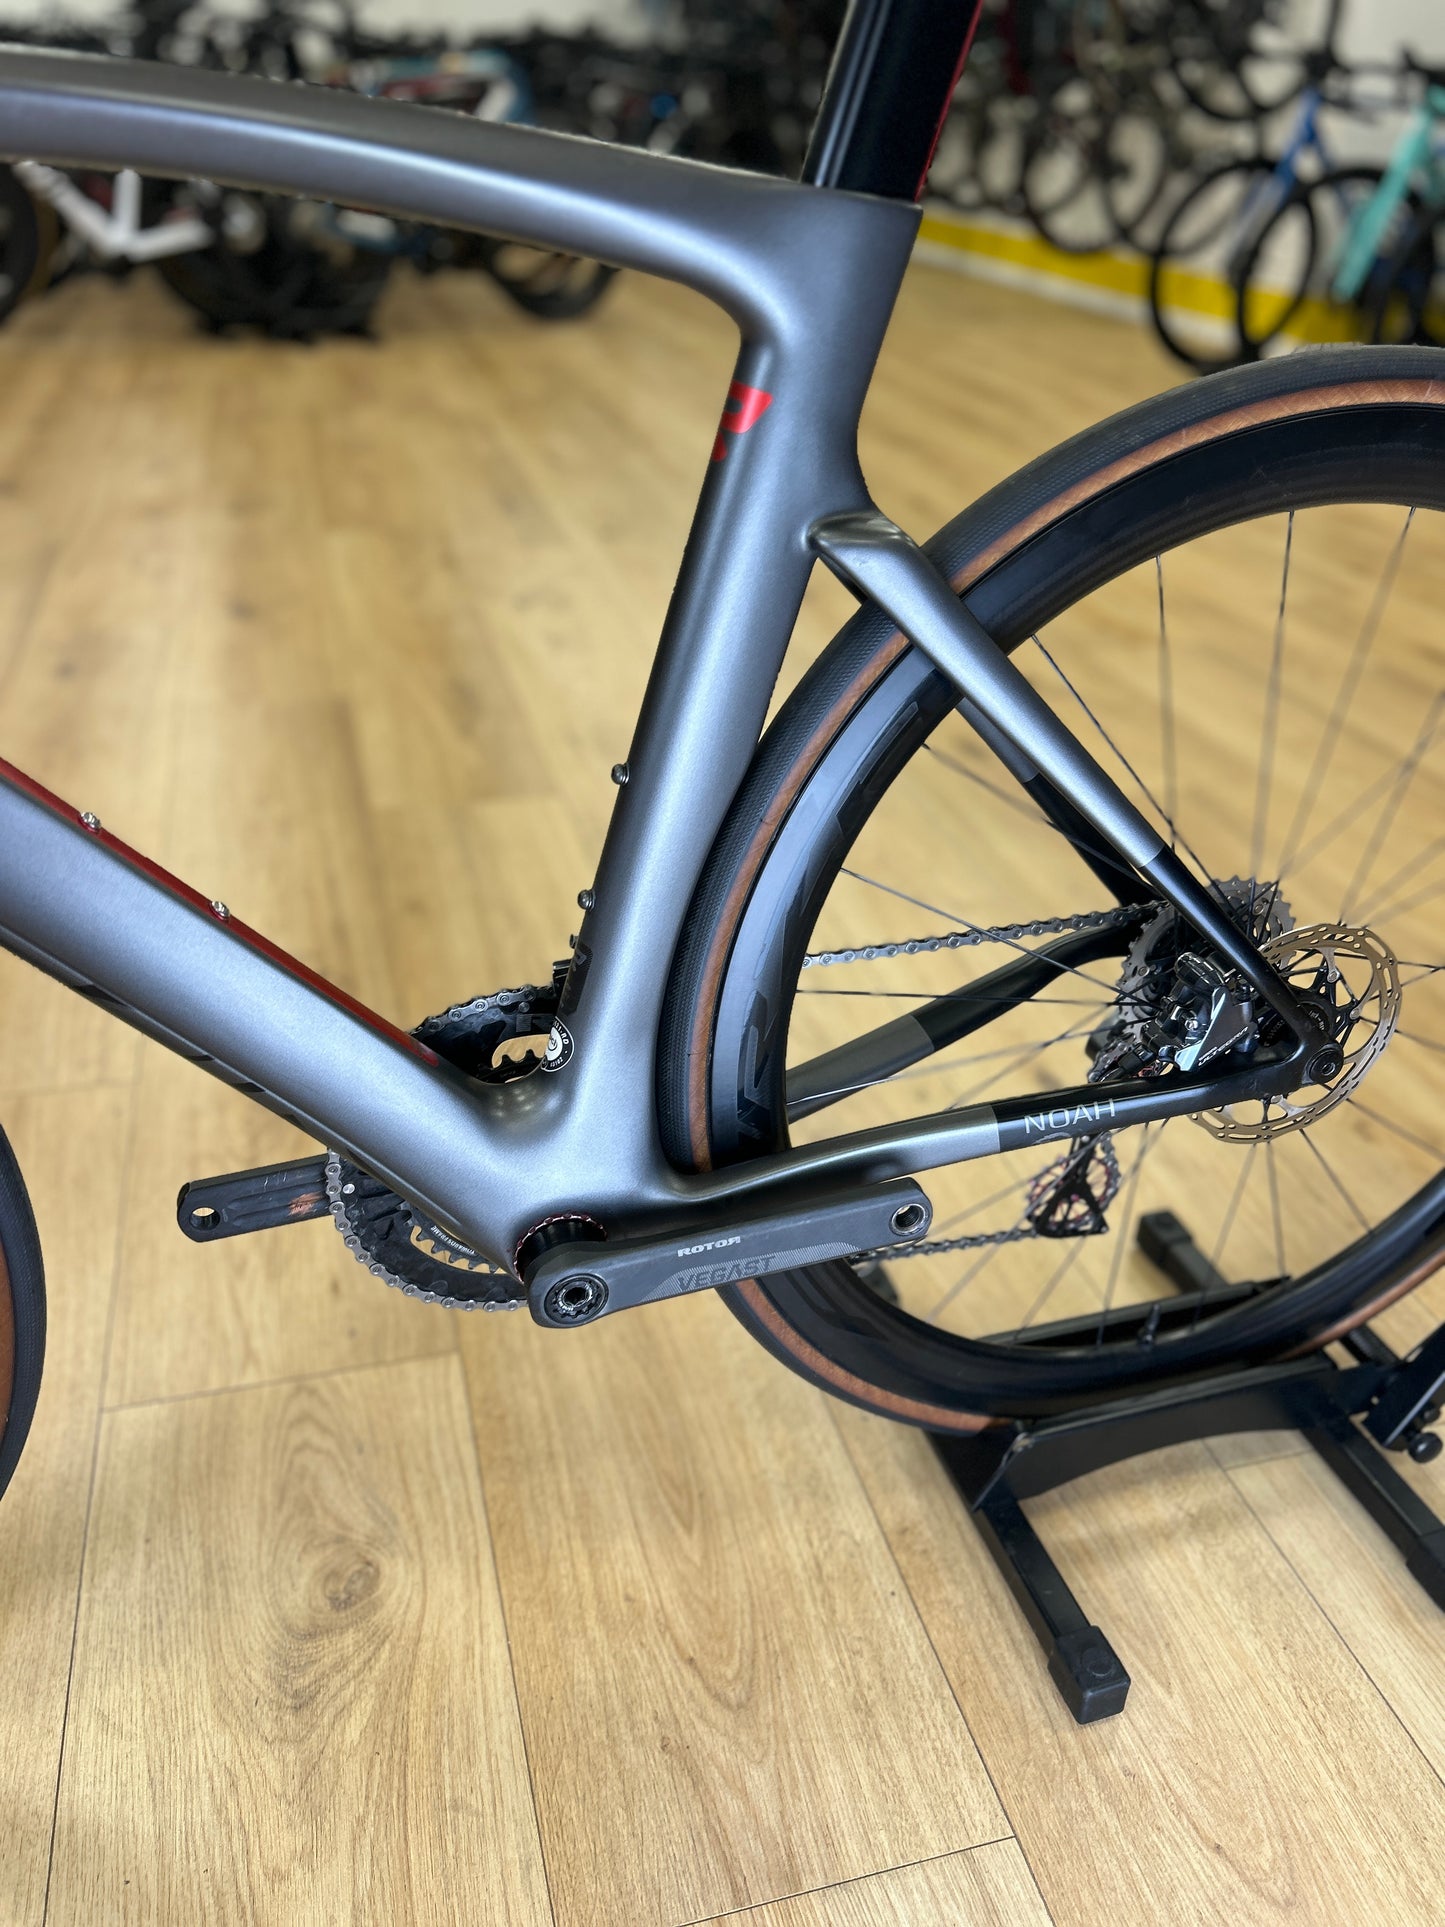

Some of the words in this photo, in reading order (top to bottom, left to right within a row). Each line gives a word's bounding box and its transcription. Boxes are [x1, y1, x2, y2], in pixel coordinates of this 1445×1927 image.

[1024, 1098, 1115, 1134] NOAH
[677, 1235, 741, 1257] ROTOR
[677, 1255, 776, 1291] VEGAST
